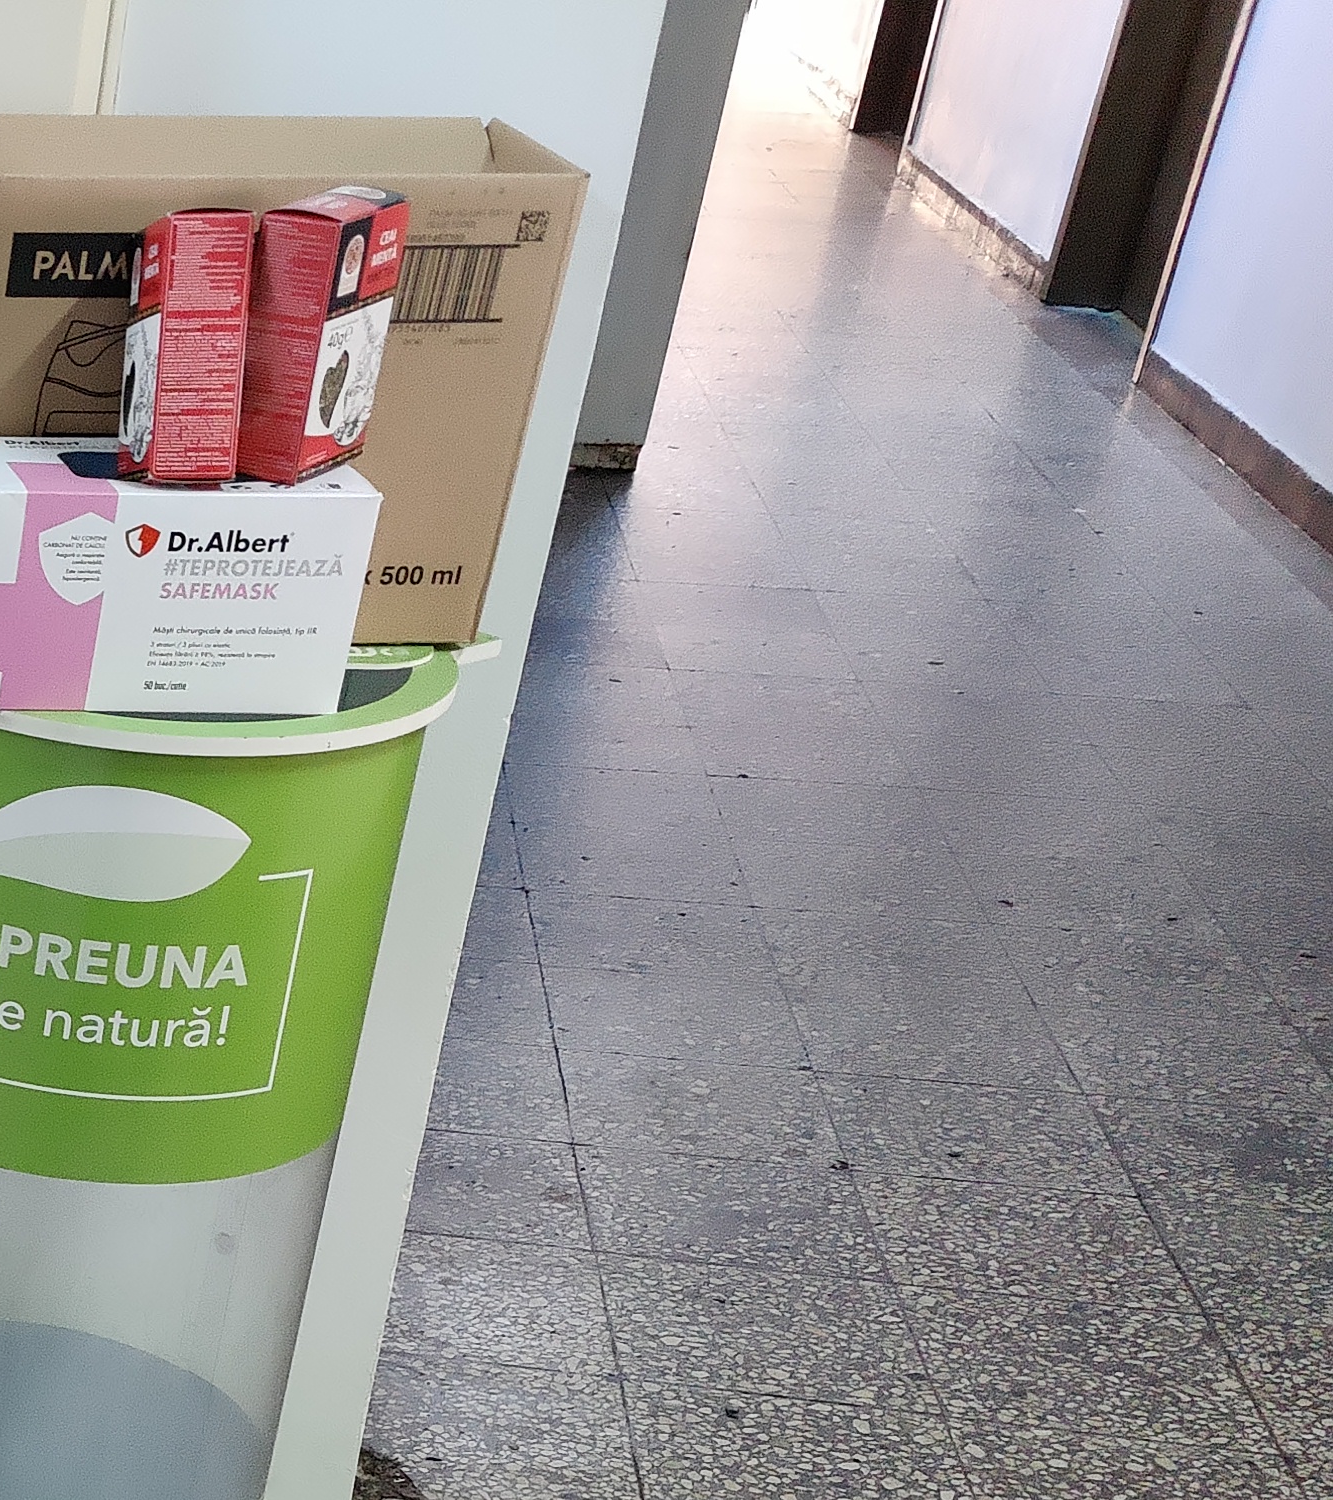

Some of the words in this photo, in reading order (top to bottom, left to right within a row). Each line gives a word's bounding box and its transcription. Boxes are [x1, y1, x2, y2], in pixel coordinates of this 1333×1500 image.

[167, 530, 290, 553] Dr.Albert
[163, 553, 344, 577] #TEPROTEJEAZĂ
[379, 565, 425, 586] 500
[431, 565, 463, 586] ml
[159, 582, 280, 600] SAFEMASK
[42, 1005, 231, 1048] natură!
